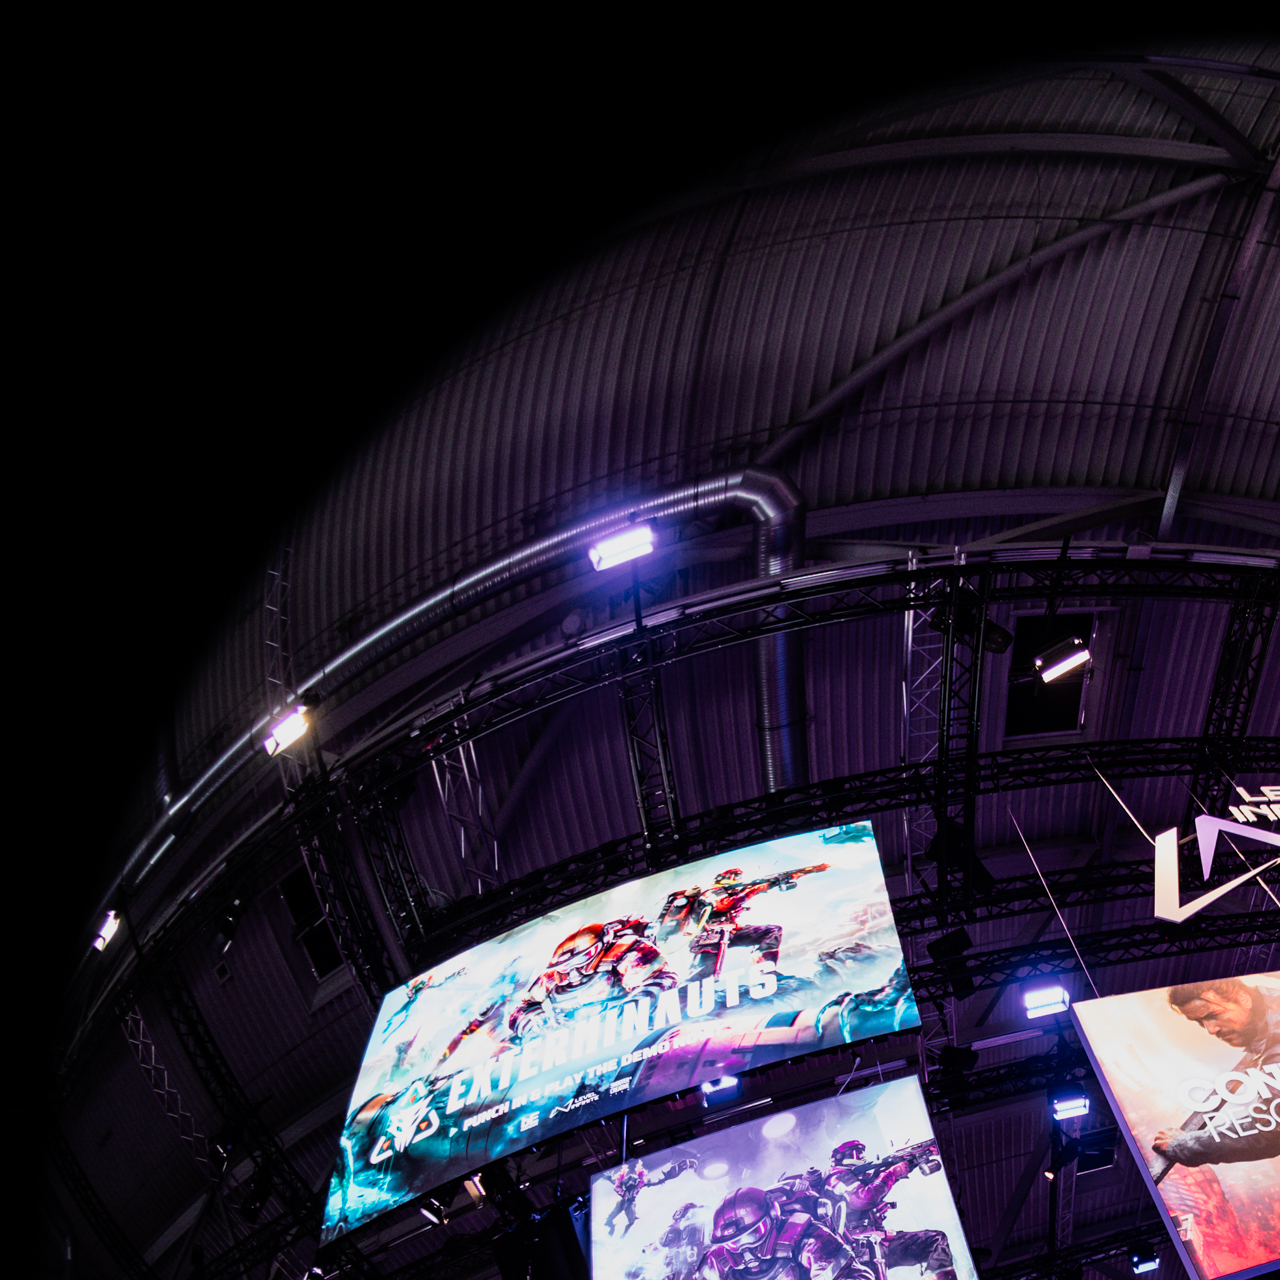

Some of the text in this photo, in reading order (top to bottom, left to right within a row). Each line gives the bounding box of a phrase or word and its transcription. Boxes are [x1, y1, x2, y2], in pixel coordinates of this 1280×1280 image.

[445, 961, 778, 1115] EXTERMINAUTS
[463, 1102, 509, 1132] PUNCH
[511, 1093, 528, 1111] IN
[530, 1087, 542, 1102] &
[545, 1070, 585, 1096] PLAY
[586, 1058, 619, 1079] THE
[621, 1040, 670, 1068] DEMO
[574, 1091, 597, 1103] LEVEL
